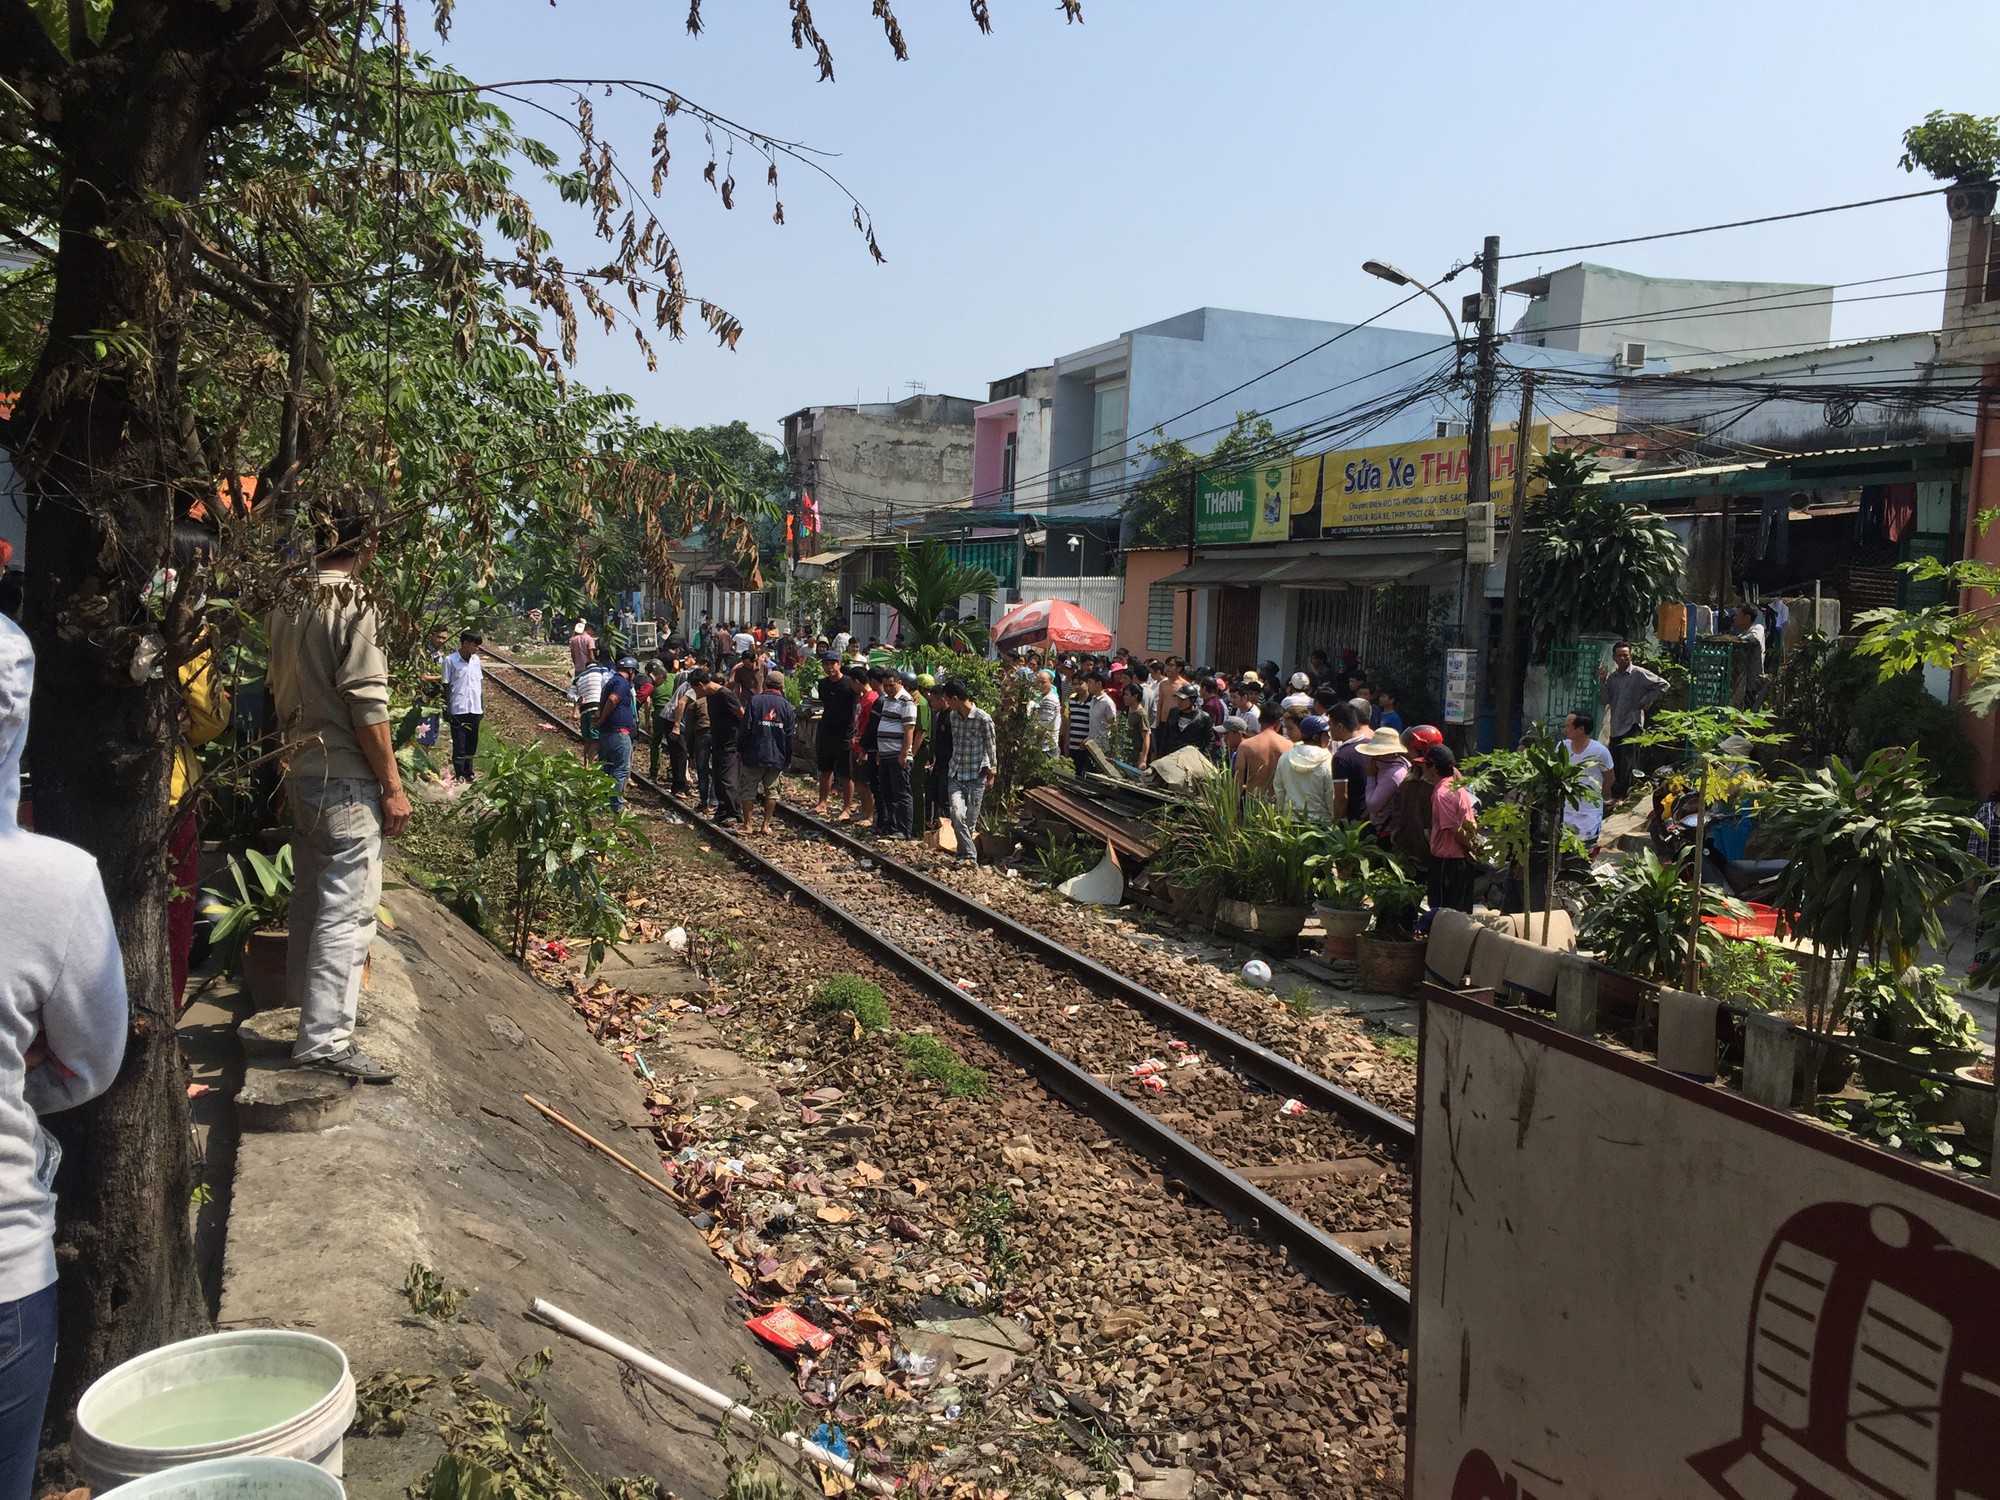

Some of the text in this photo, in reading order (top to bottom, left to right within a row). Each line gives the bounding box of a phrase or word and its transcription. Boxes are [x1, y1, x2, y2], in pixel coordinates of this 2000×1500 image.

[1344, 458, 1382, 494] Sửa
[1387, 456, 1415, 489] Xe
[1204, 490, 1244, 515] THANH
[1402, 496, 1424, 505] HONDA
